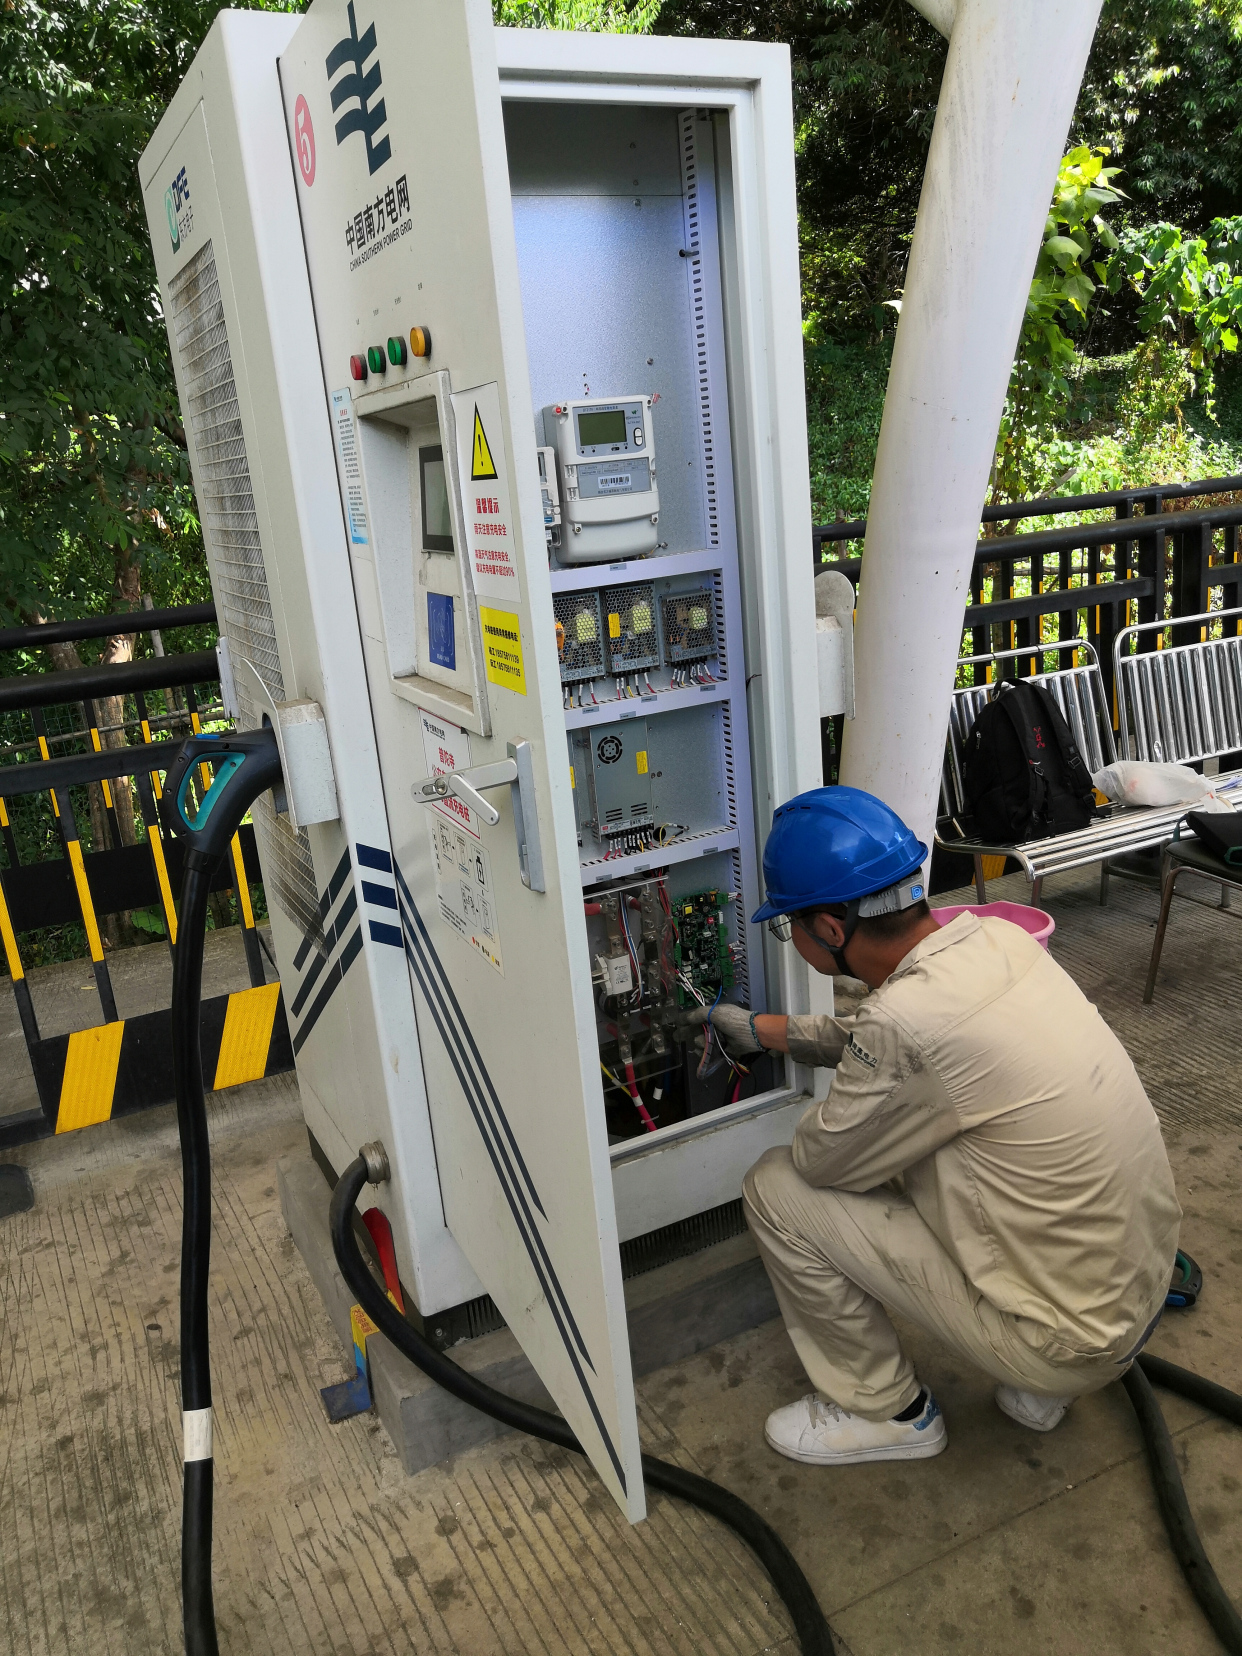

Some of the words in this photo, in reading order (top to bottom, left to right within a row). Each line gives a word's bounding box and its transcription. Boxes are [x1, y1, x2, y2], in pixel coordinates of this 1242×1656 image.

[298, 107, 312, 174] 5
[345, 173, 410, 256] 中国南方电网
[349, 256, 362, 272] CHINA
[361, 241, 384, 264] SOUTHERN
[383, 227, 401, 248] POWER
[400, 218, 413, 236] GRID
[475, 497, 500, 514] 温馨提示
[441, 797, 471, 823] 直流充电桩
